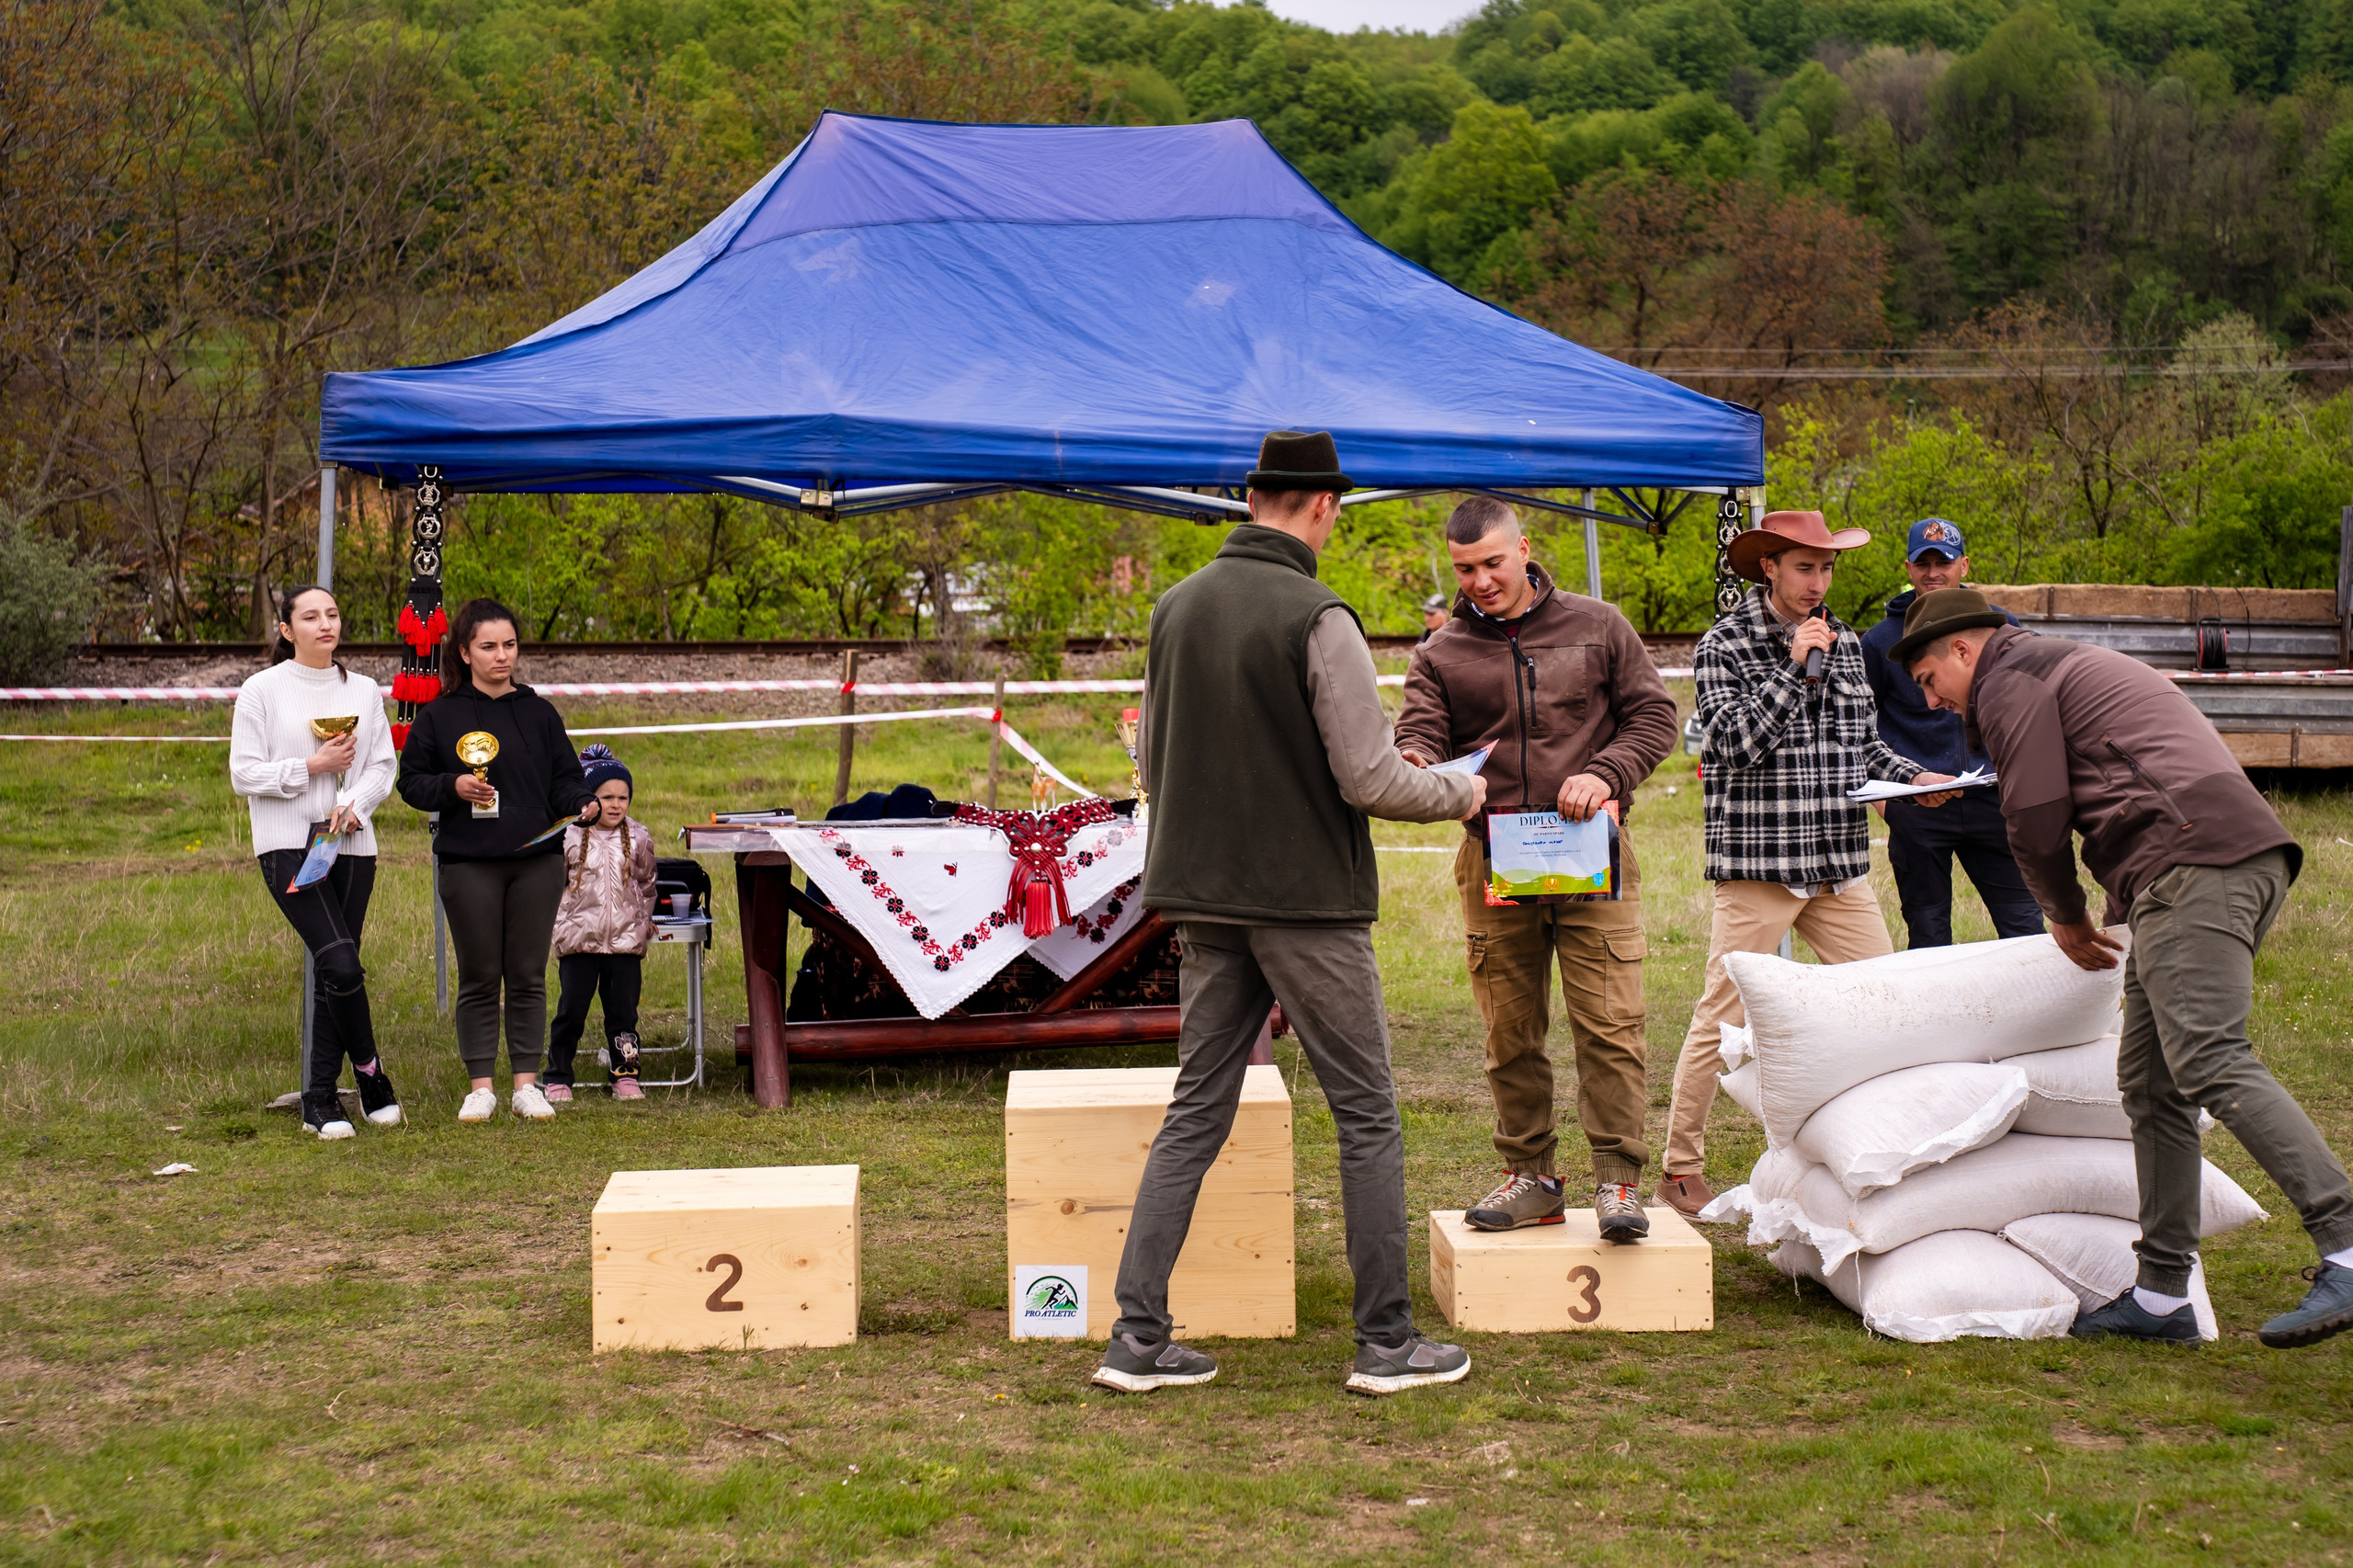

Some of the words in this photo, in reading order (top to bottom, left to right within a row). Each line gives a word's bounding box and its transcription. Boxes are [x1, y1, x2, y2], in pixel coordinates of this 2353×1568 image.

[1519, 814, 1572, 826] DIPLOM
[705, 1254, 744, 1312] 2
[1566, 1265, 1601, 1324] 3
